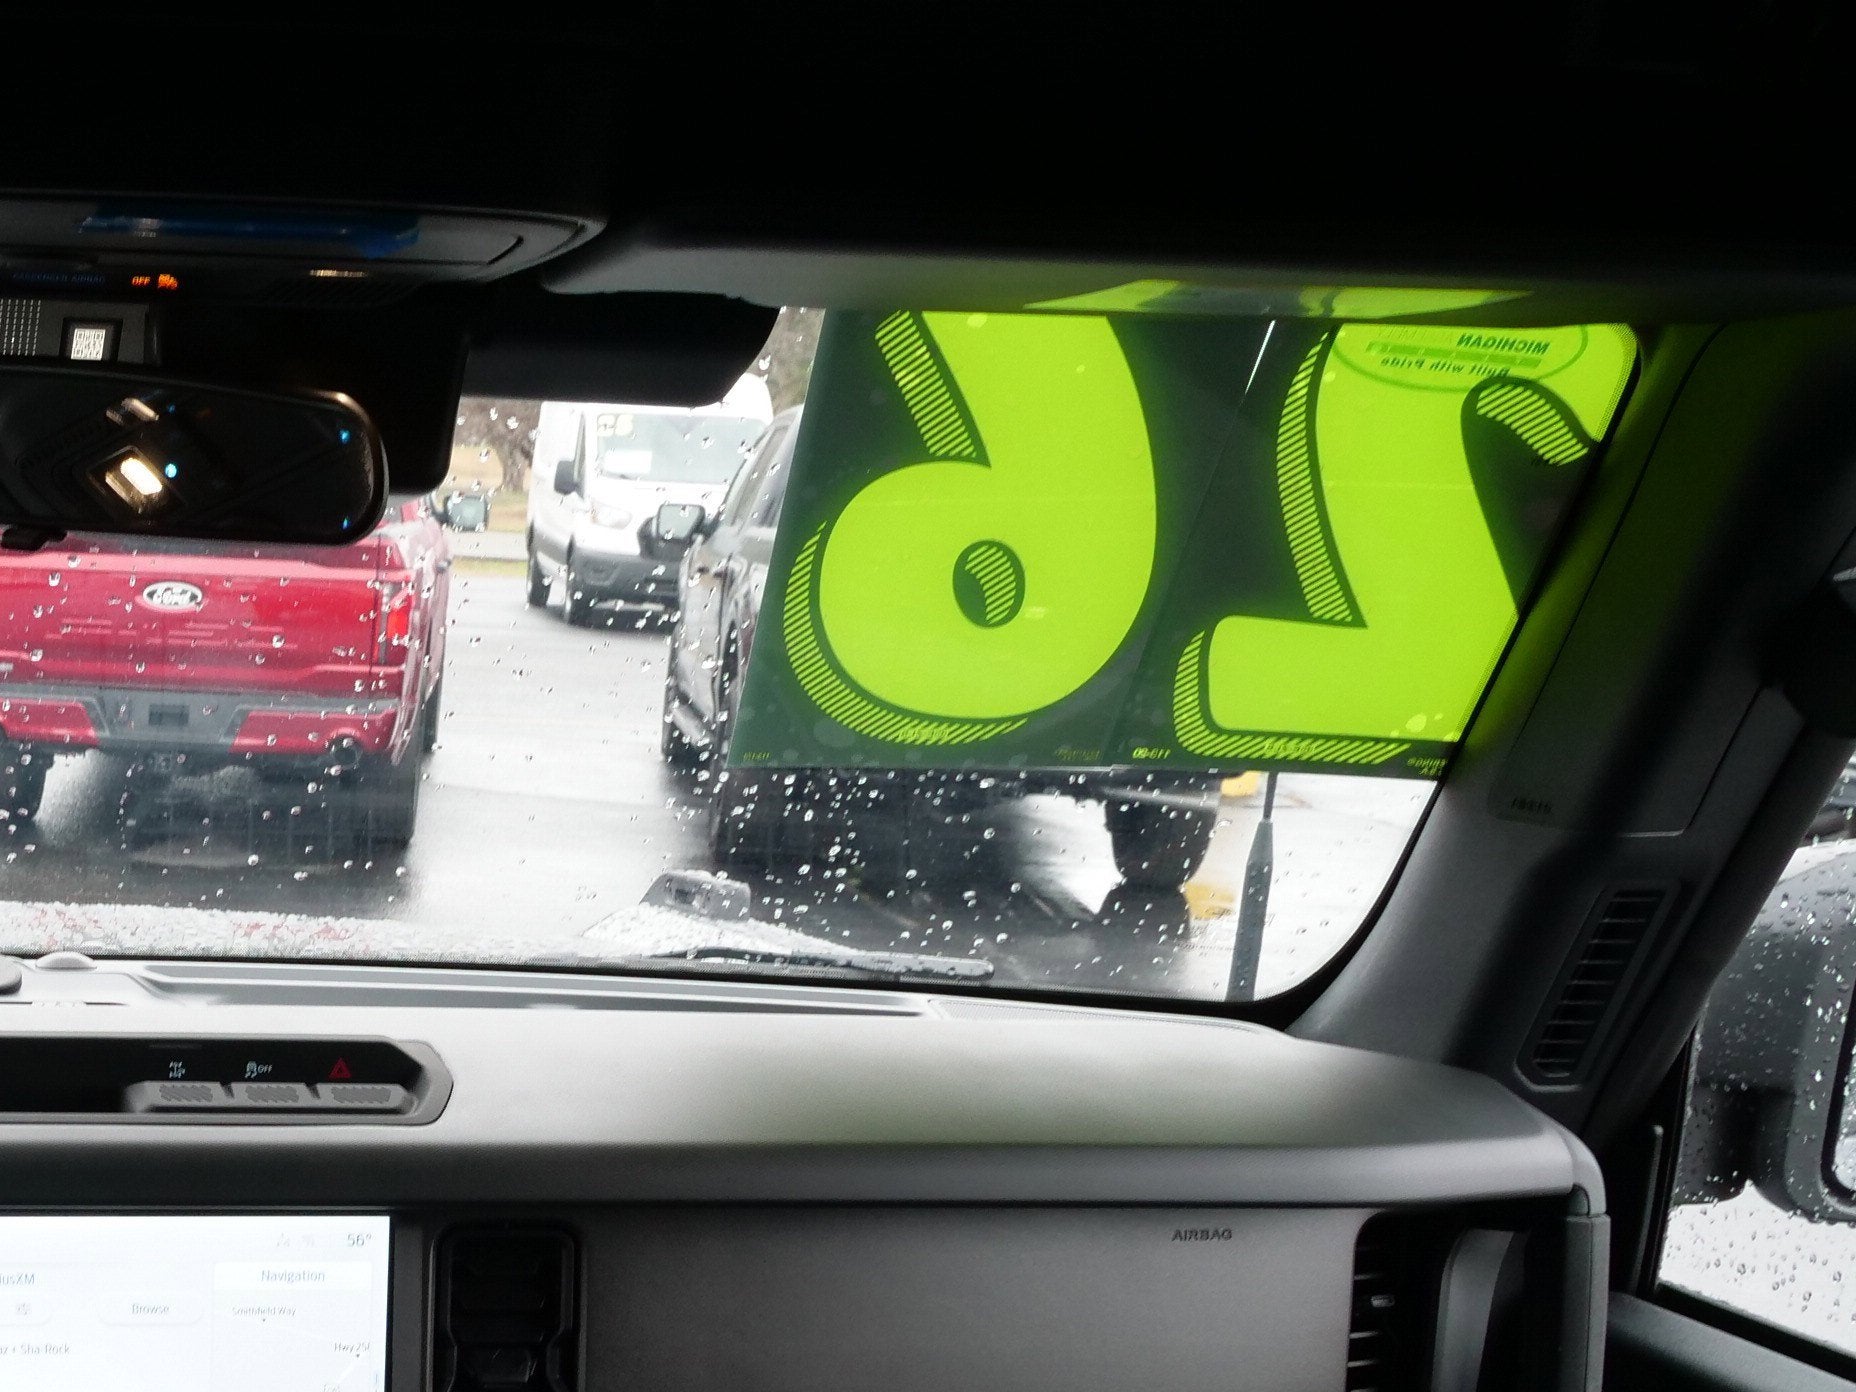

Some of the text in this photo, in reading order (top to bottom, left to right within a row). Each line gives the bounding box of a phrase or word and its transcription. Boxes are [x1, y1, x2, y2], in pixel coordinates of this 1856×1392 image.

[131, 275, 151, 287] OFF
[1172, 1228, 1234, 1242] AIRBAG
[261, 1269, 326, 1284] Navigation
[131, 1303, 170, 1316] Browse
